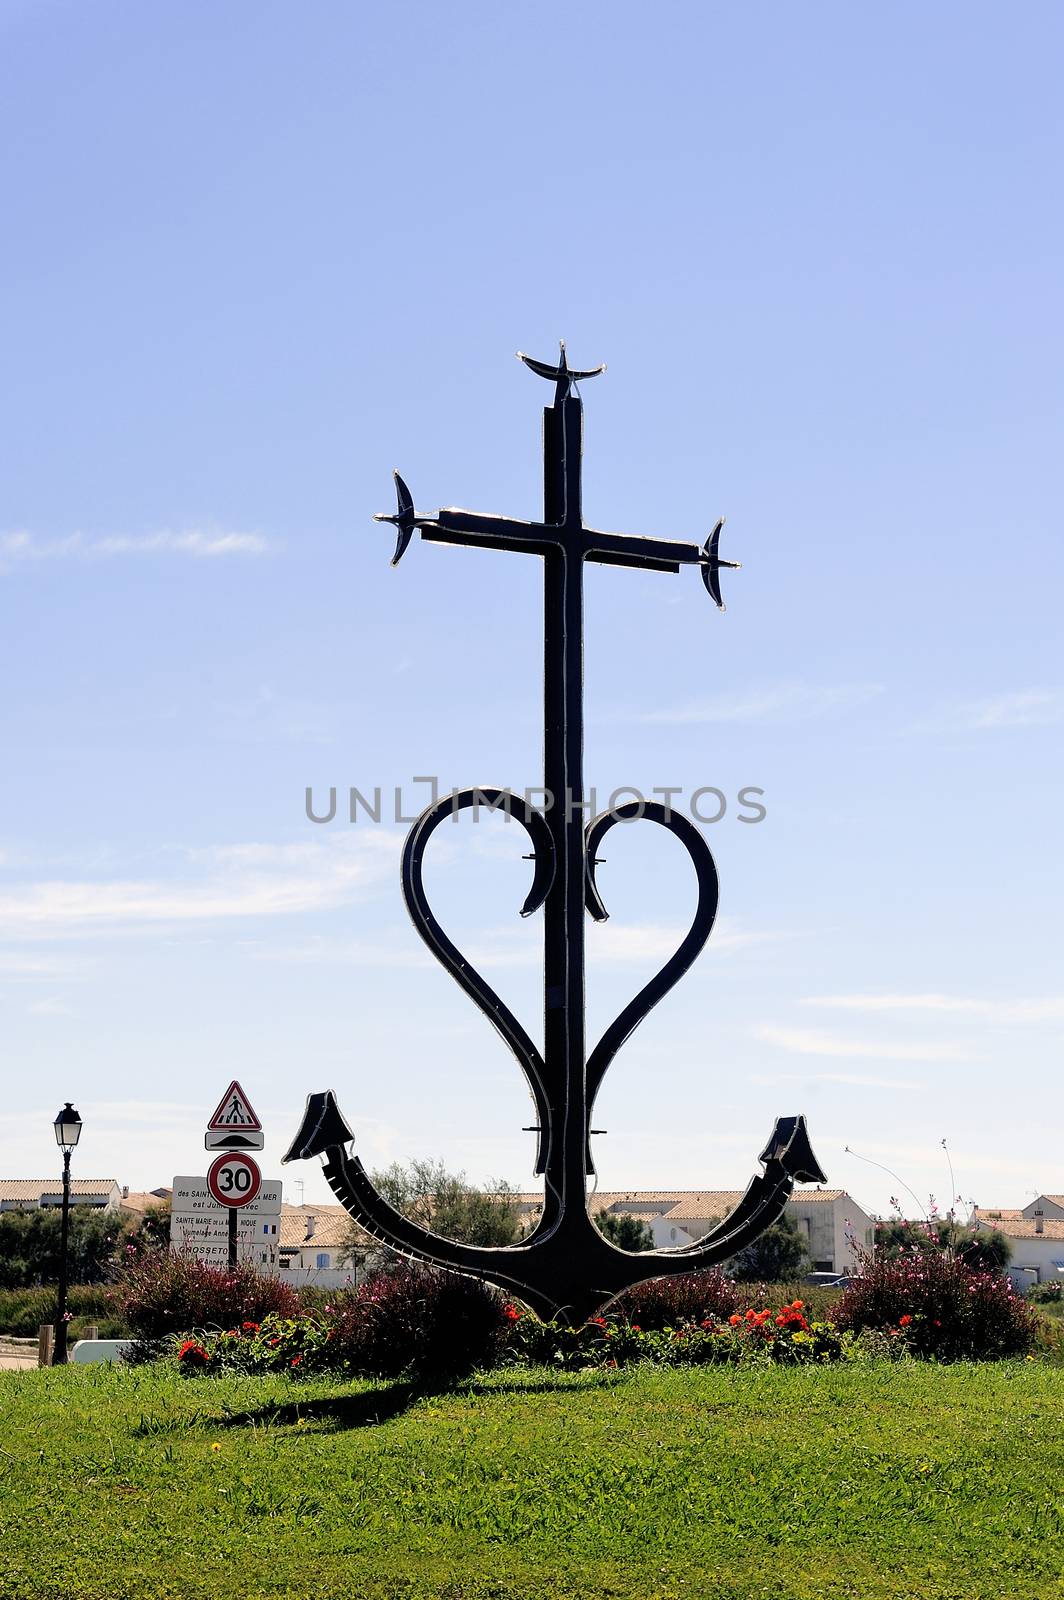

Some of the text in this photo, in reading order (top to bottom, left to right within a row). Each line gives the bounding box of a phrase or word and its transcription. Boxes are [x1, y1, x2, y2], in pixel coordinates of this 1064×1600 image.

[219, 1167, 251, 1192] 30
[191, 1190, 212, 1198] SAINT
[262, 1193, 277, 1201] MER
[206, 1201, 226, 1209] Jum
[175, 1216, 194, 1225] SAINTE
[195, 1217, 212, 1225] MARIE
